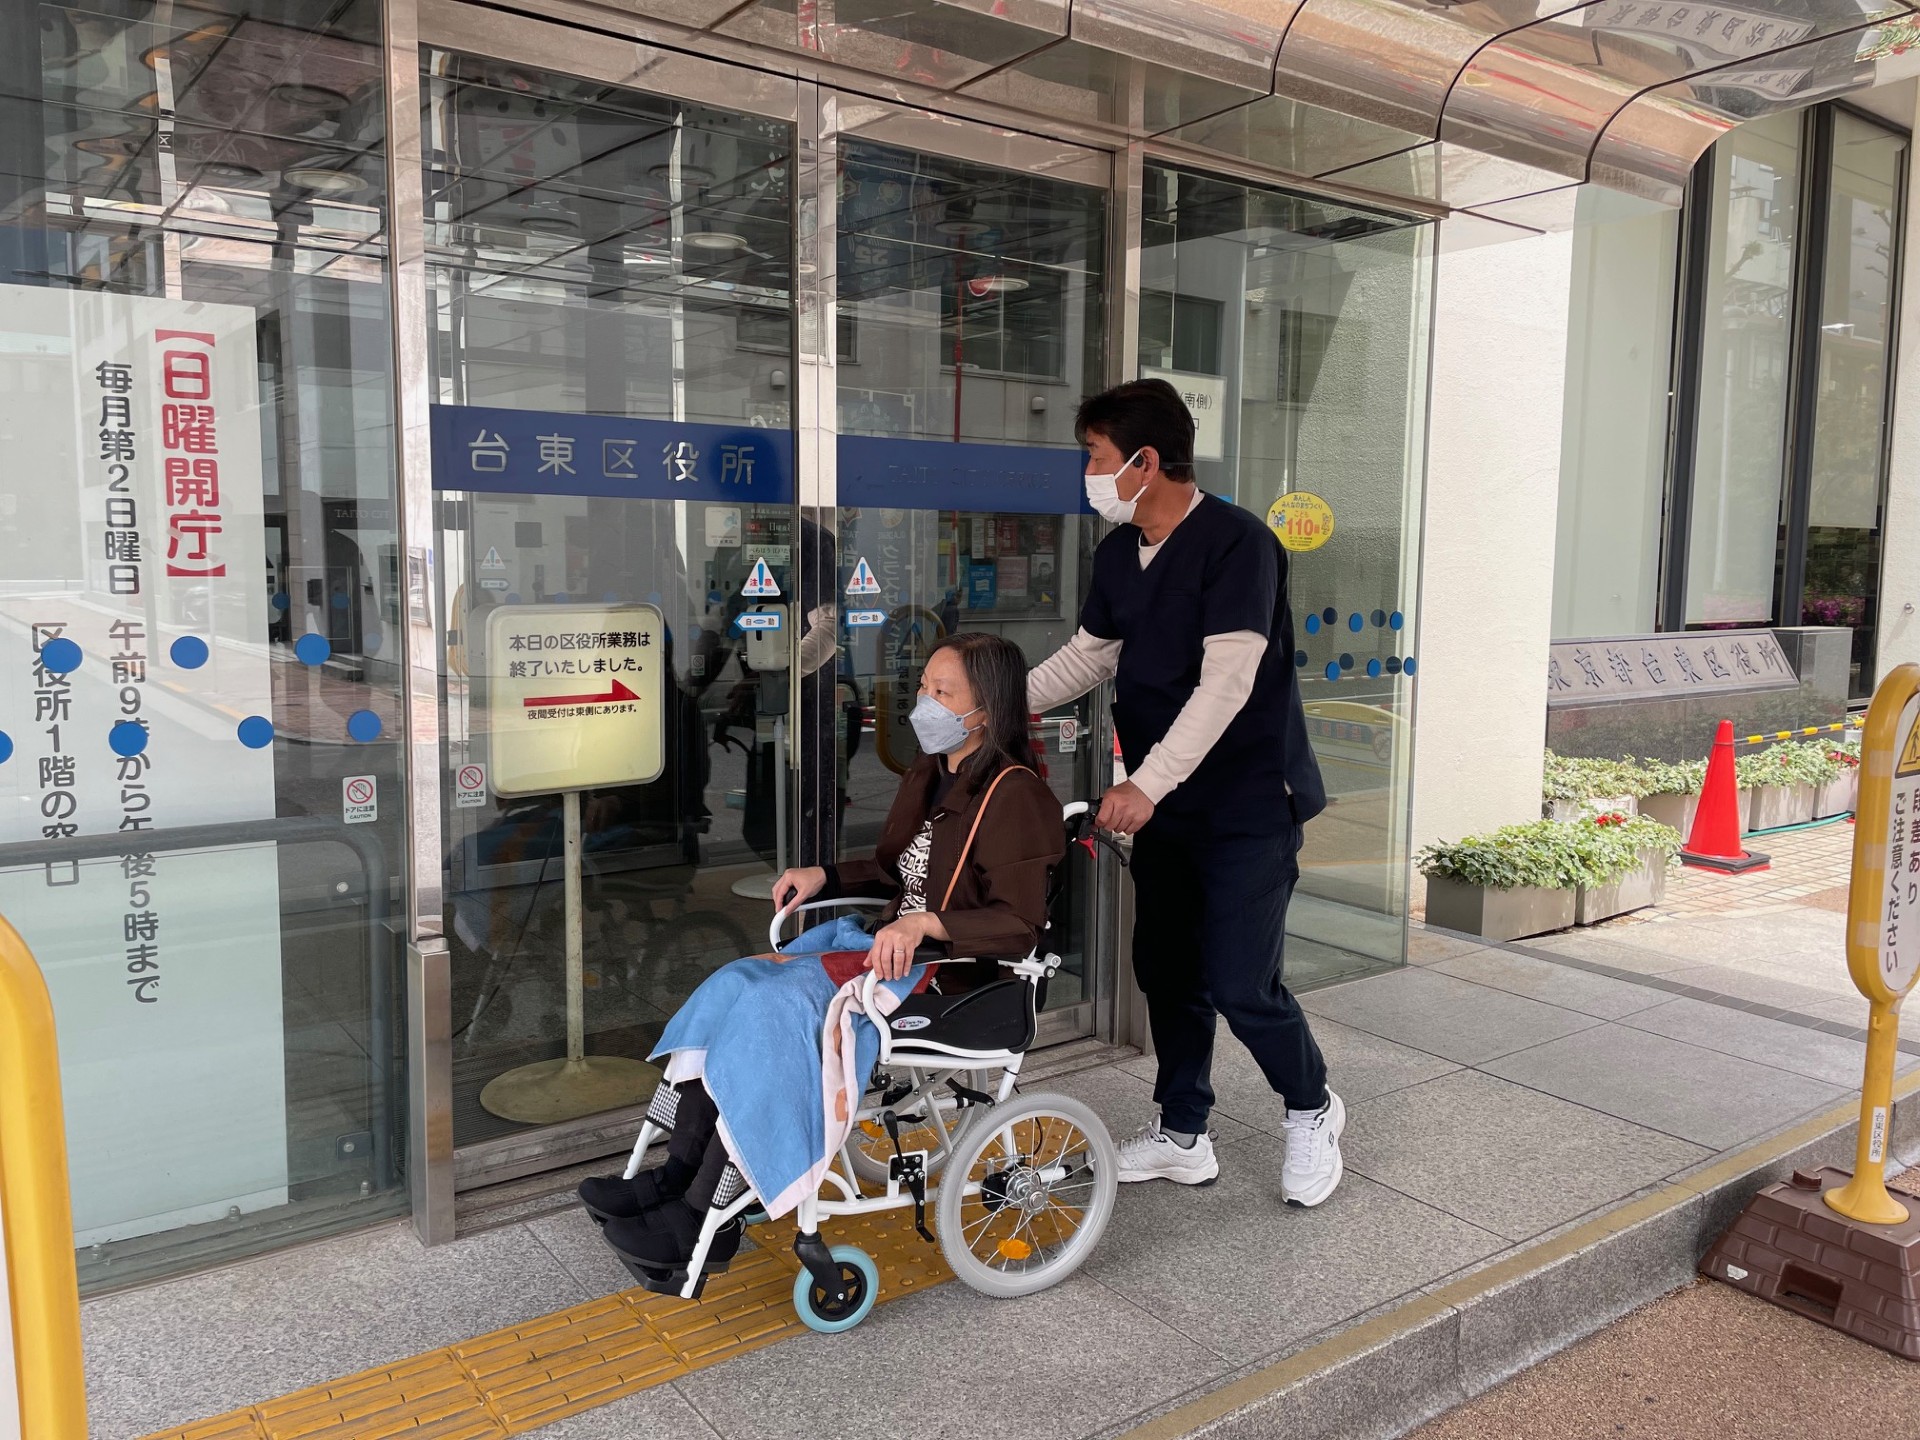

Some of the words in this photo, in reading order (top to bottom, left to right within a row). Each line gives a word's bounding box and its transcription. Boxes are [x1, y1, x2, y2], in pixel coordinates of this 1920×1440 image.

[155, 329, 226, 577] 【日曜開庁】
[468, 428, 756, 486] 台東区役所
[96, 360, 141, 595] 毎月第2日曜日
[509, 632, 651, 651] 本日の区役所業務は
[509, 657, 643, 678] 終了いたしました。
[527, 704, 638, 720] 夜間受付は東側にあります。
[458, 790, 485, 799] ドアに注意
[345, 805, 375, 813] ドアに注意
[1886, 792, 1907, 974] ご注意ください
